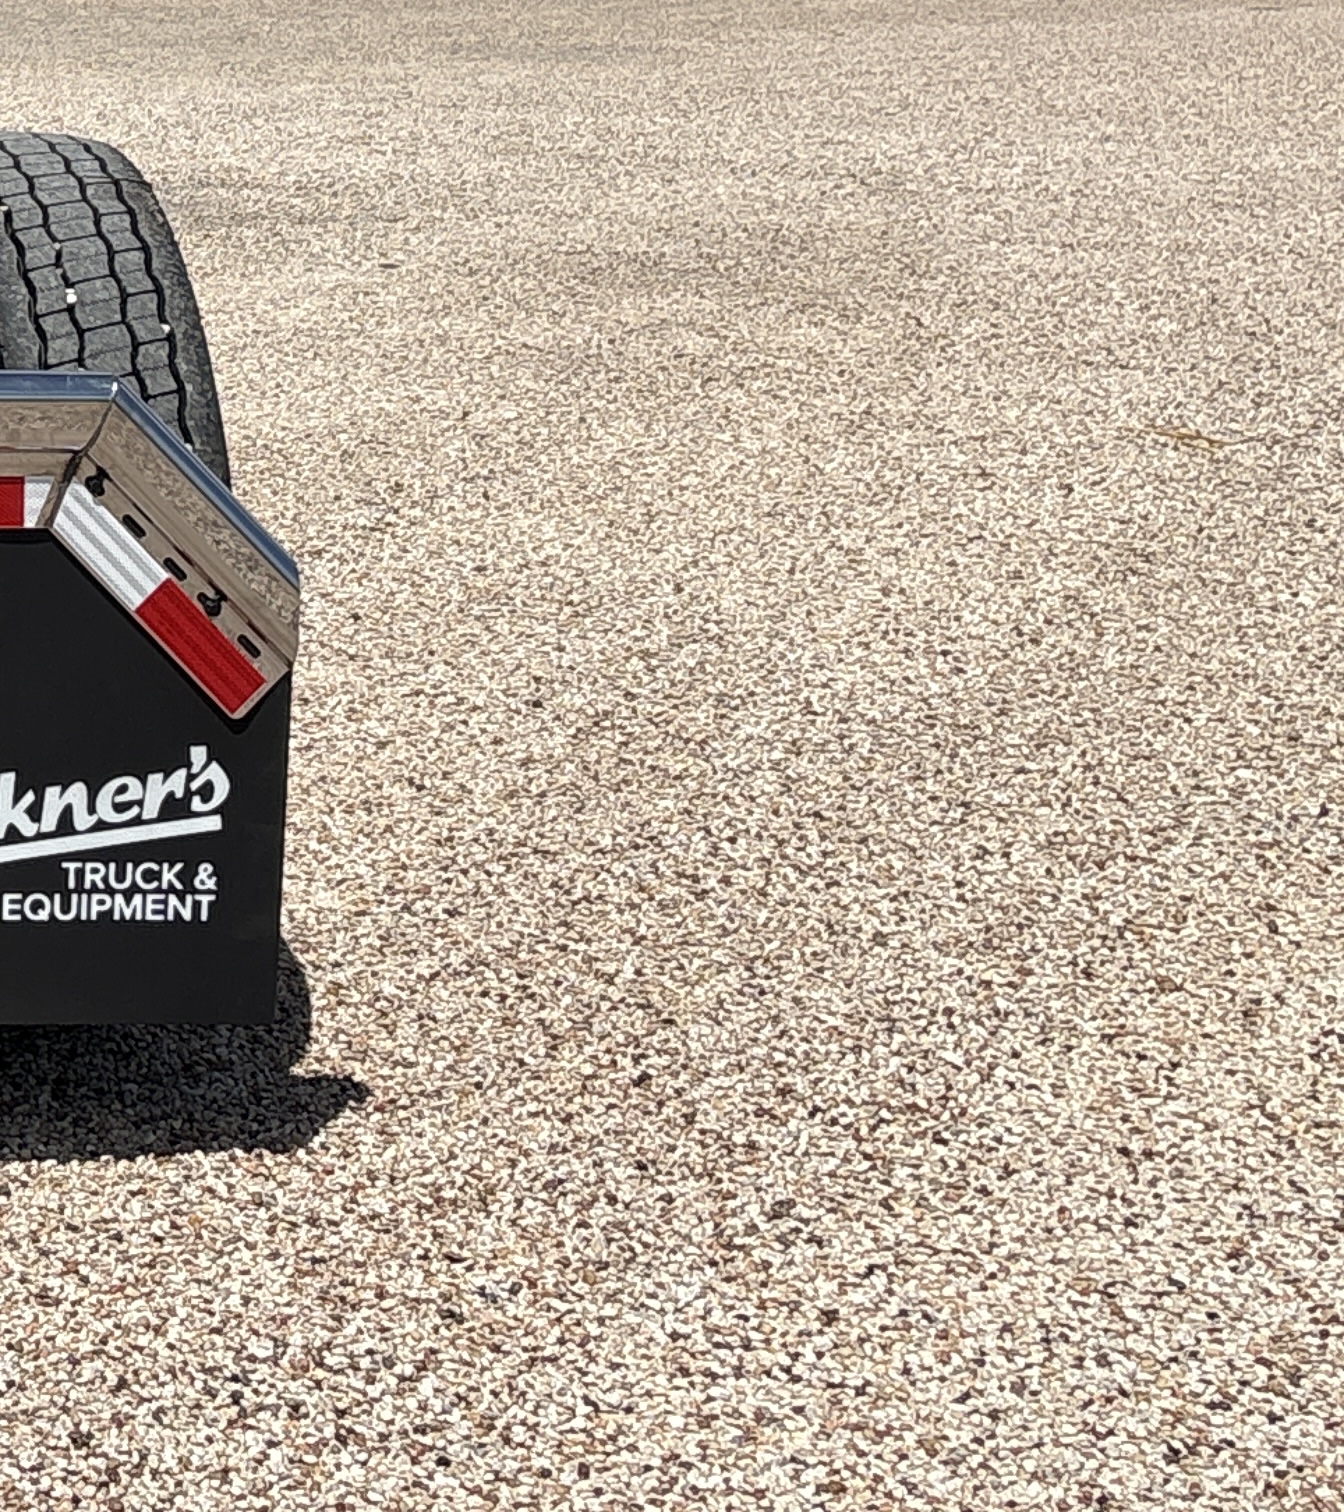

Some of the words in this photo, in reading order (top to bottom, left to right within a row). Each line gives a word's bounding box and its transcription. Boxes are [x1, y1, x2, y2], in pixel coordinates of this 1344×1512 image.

[61, 861, 185, 891] TRUCK
[193, 862, 218, 891] &
[2, 892, 217, 922] EQUIPMENT
